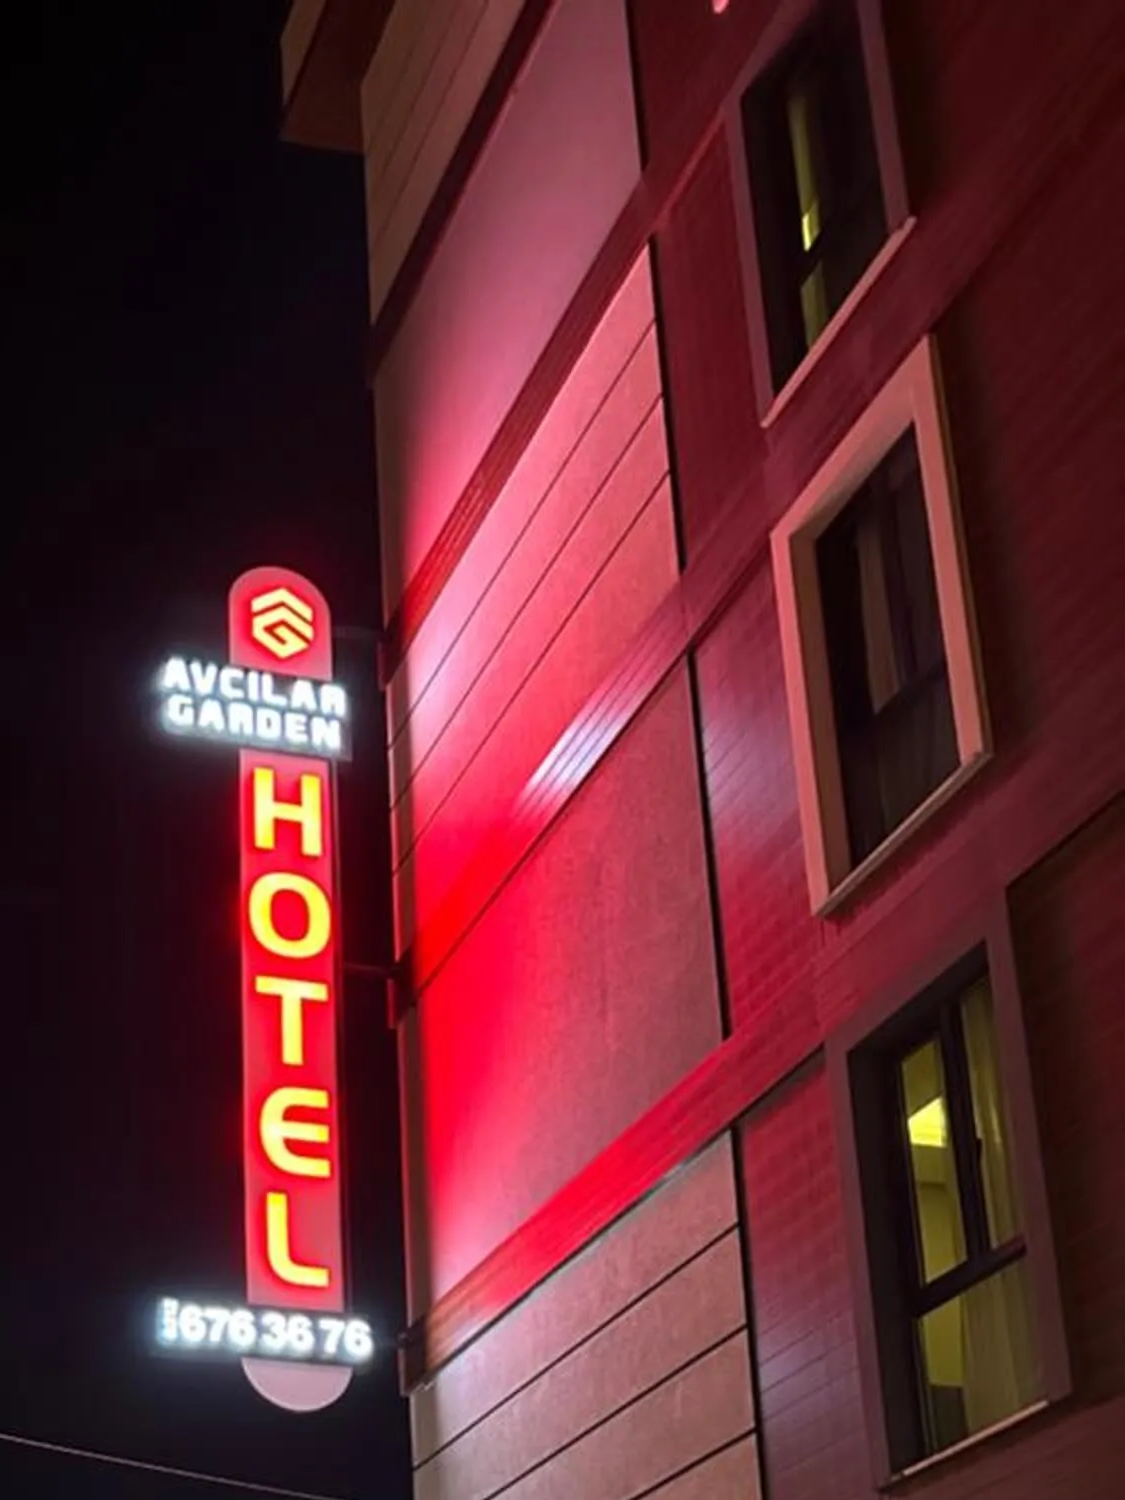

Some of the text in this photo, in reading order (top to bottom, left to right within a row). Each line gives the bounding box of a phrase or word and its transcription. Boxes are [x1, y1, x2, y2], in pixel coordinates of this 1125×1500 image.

[162, 656, 347, 718] AVCILAR
[167, 693, 342, 750] GARDEN
[248, 766, 331, 1288] HOTEL
[179, 1304, 257, 1347] 676
[261, 1310, 315, 1352] 36
[318, 1317, 374, 1359] 76
